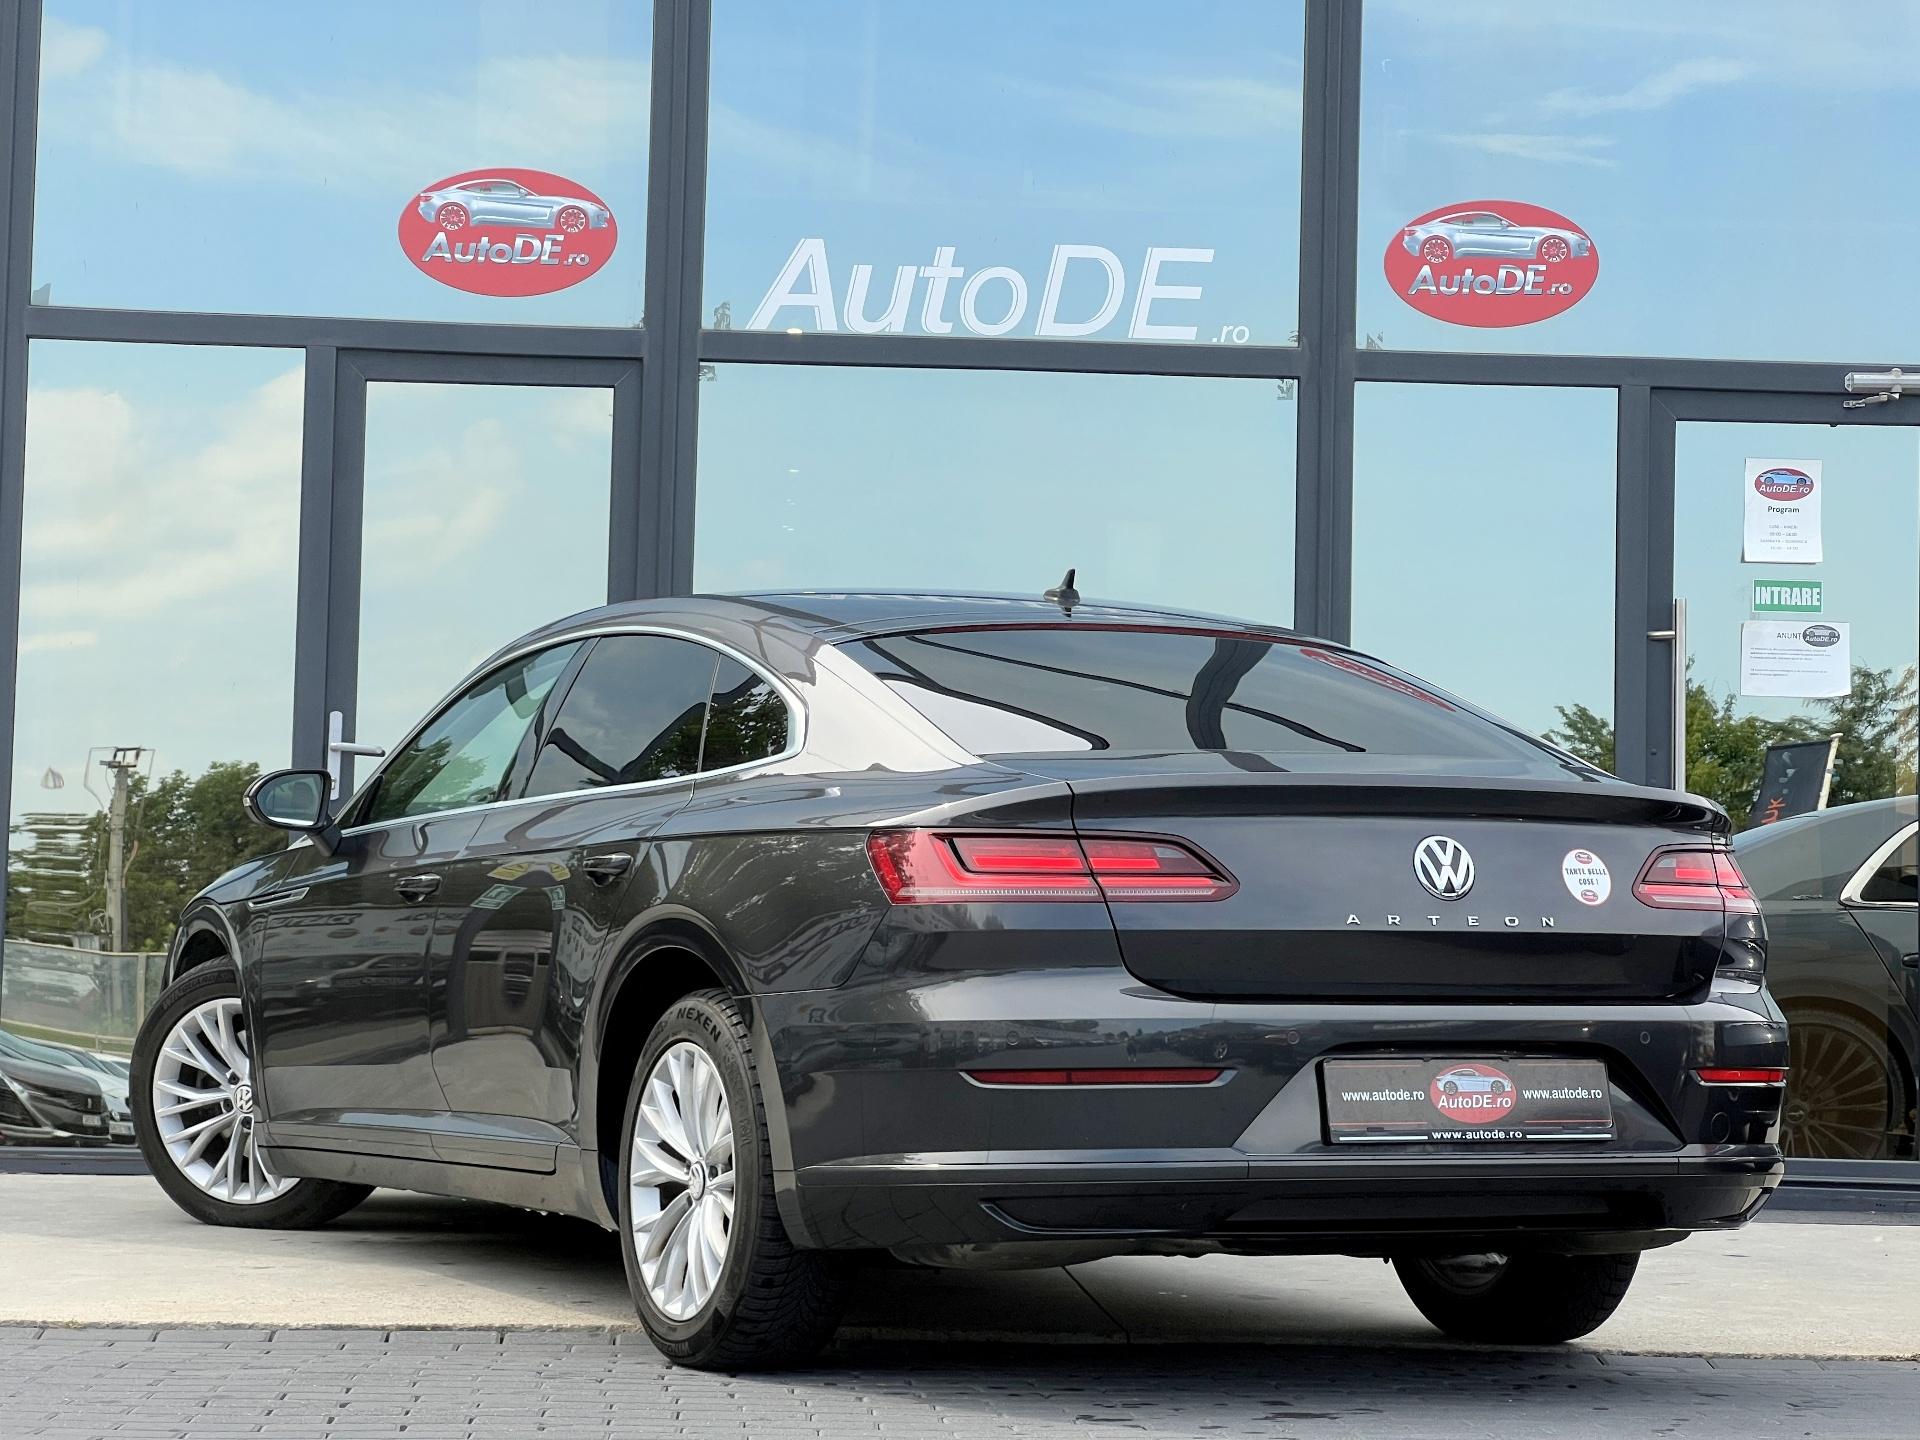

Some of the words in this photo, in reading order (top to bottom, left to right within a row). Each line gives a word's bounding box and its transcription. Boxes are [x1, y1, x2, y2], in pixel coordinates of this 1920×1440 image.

[1759, 484, 1810, 494] AutoDE.ro
[1767, 505, 1800, 514] Program
[1755, 586, 1821, 606] INTRARE
[1346, 914, 1555, 928] ARTEON
[676, 1007, 722, 1043] NEXEN
[1341, 1088, 1425, 1102] www.autode.ro
[1522, 1087, 1603, 1100] www.autode.ro
[1437, 1094, 1512, 1110] AutoDE.ro
[1431, 1129, 1523, 1140] www.autode.ro
